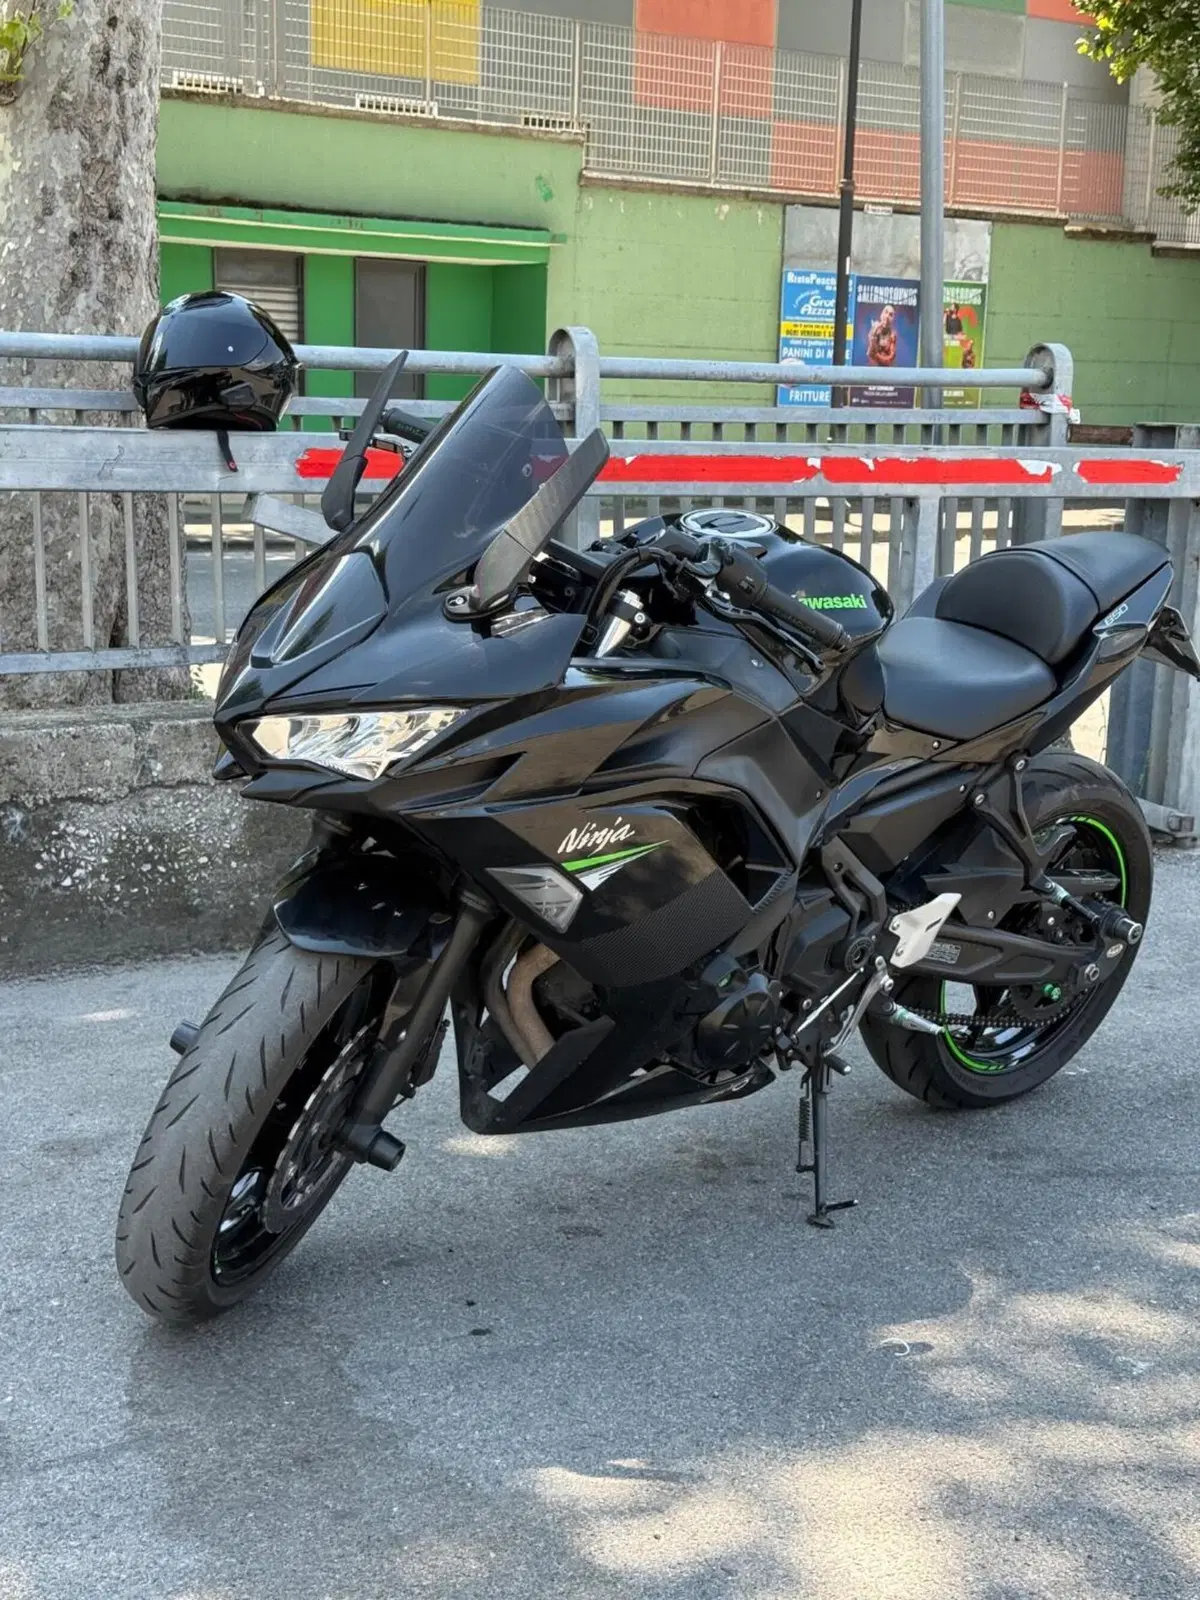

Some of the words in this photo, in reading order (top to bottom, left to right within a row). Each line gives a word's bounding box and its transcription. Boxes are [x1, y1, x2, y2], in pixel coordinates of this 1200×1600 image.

[782, 347, 813, 358] PANINI
[815, 348, 825, 358] DI
[789, 390, 830, 402] FRITTURE
[798, 593, 867, 609] awasaki
[557, 816, 635, 857] Ninja
